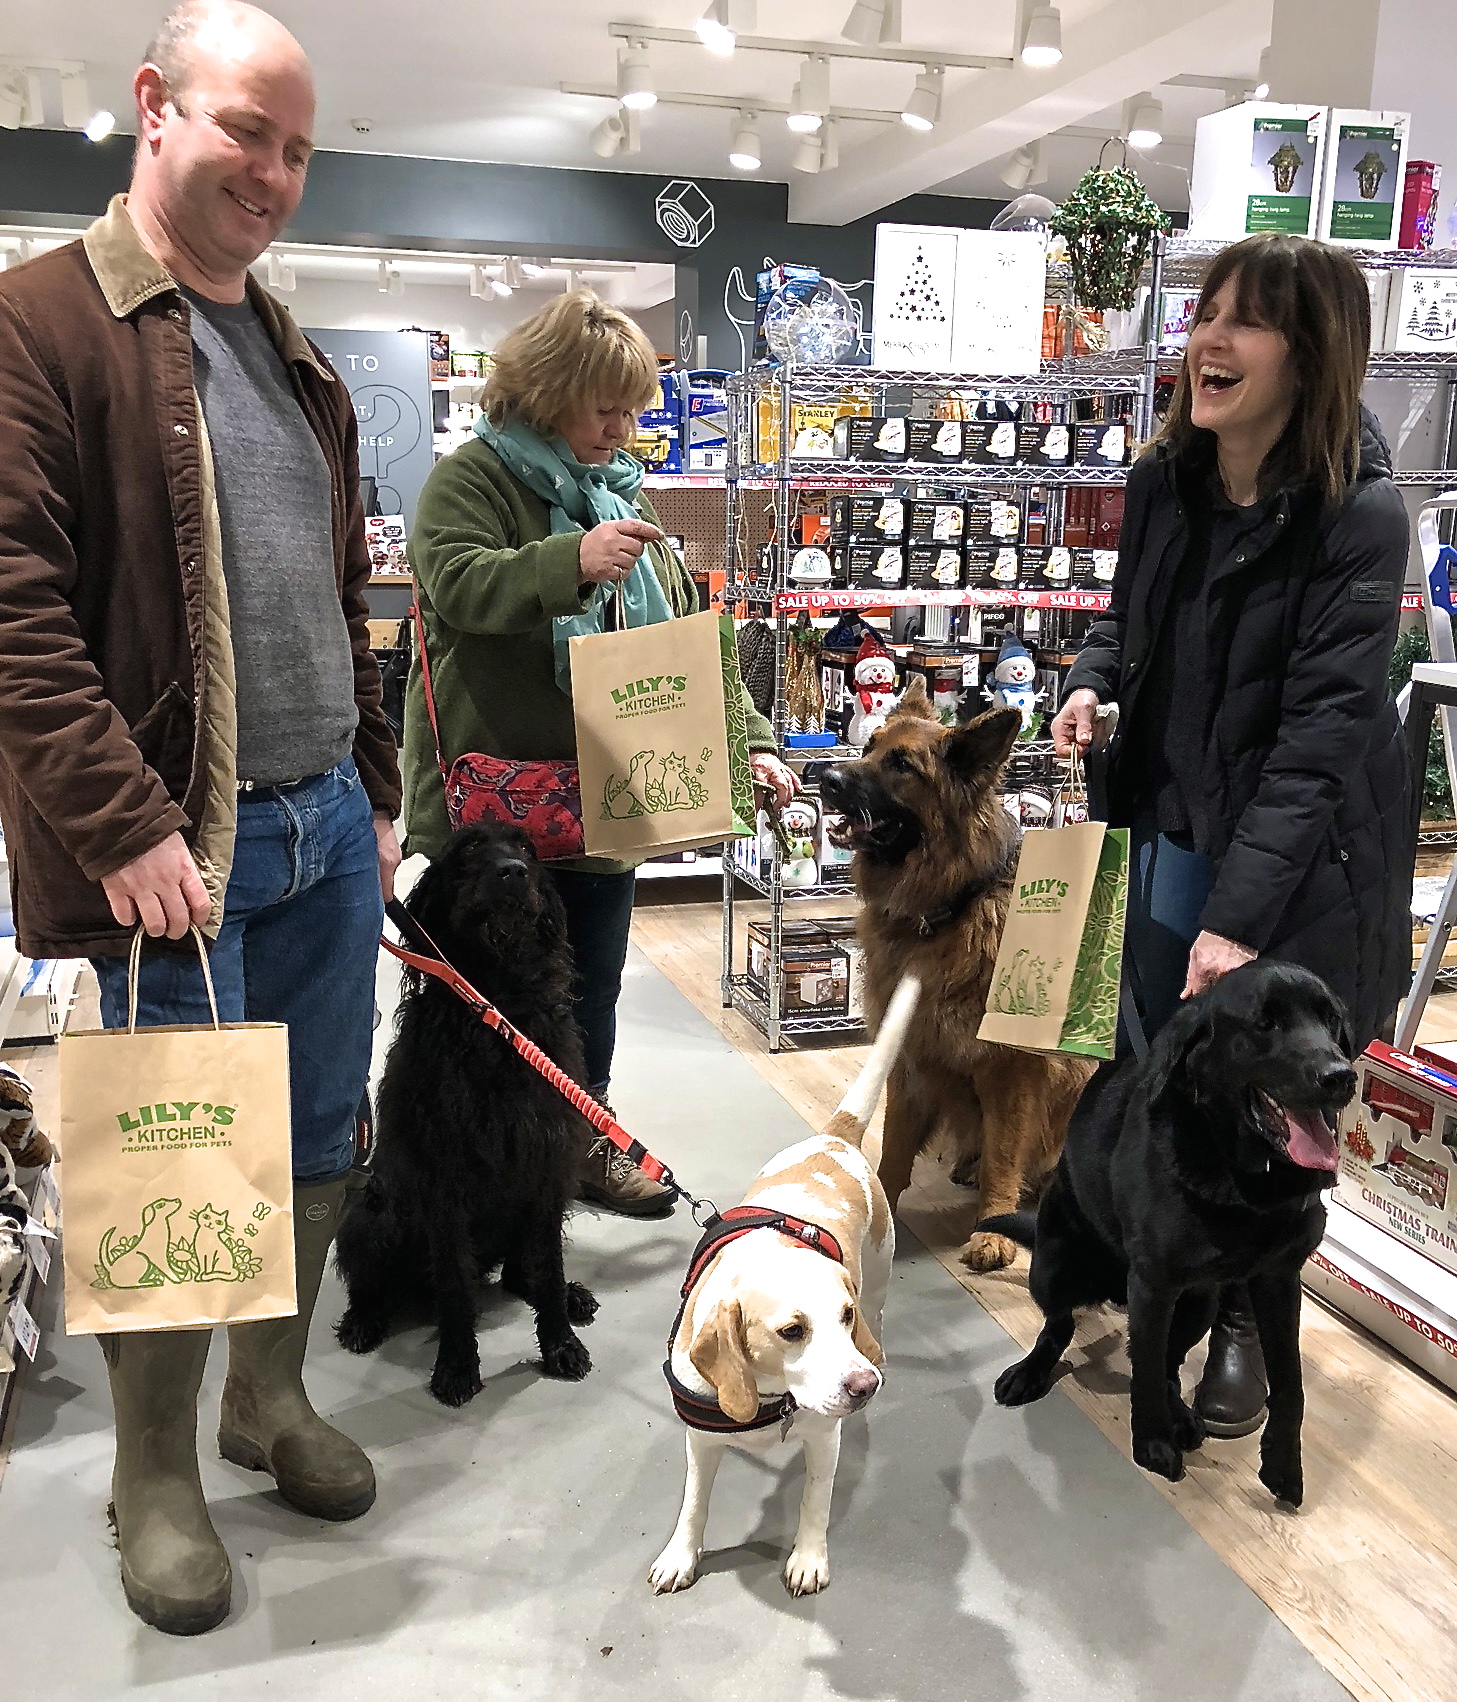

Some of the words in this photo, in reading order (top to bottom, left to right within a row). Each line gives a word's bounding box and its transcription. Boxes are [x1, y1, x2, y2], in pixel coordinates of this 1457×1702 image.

[346, 354, 379, 372] TO
[359, 435, 395, 447] HELP
[778, 596, 808, 609] SALE
[811, 595, 829, 606] UP
[831, 595, 850, 606] TO
[853, 594, 882, 605] 50%
[1018, 593, 1040, 604] OFF
[1050, 594, 1077, 607] SALE
[1080, 596, 1096, 608] UP
[1097, 597, 1111, 608] TO
[1400, 597, 1419, 608] ALE
[610, 675, 687, 704] LILY'S
[625, 692, 675, 711] KITCHEN
[1020, 879, 1069, 899] LILY'S
[1025, 898, 1057, 907] KITCHEN
[115, 1101, 236, 1133] LILY'S
[137, 1126, 215, 1143] KITCHEN
[121, 1144, 158, 1153] PROPER
[161, 1143, 187, 1151] FOOD
[189, 1141, 208, 1149] FOR
[1361, 1188, 1421, 1232] CHRISTMAS
[1424, 1223, 1457, 1255] TRAIN
[1389, 1216, 1403, 1231] NEW
[1404, 1226, 1426, 1245] SERIES
[1327, 1264, 1351, 1283] OFF
[1393, 1304, 1411, 1323] UP
[1414, 1319, 1433, 1339] TO
[1437, 1336, 1457, 1354] 50
